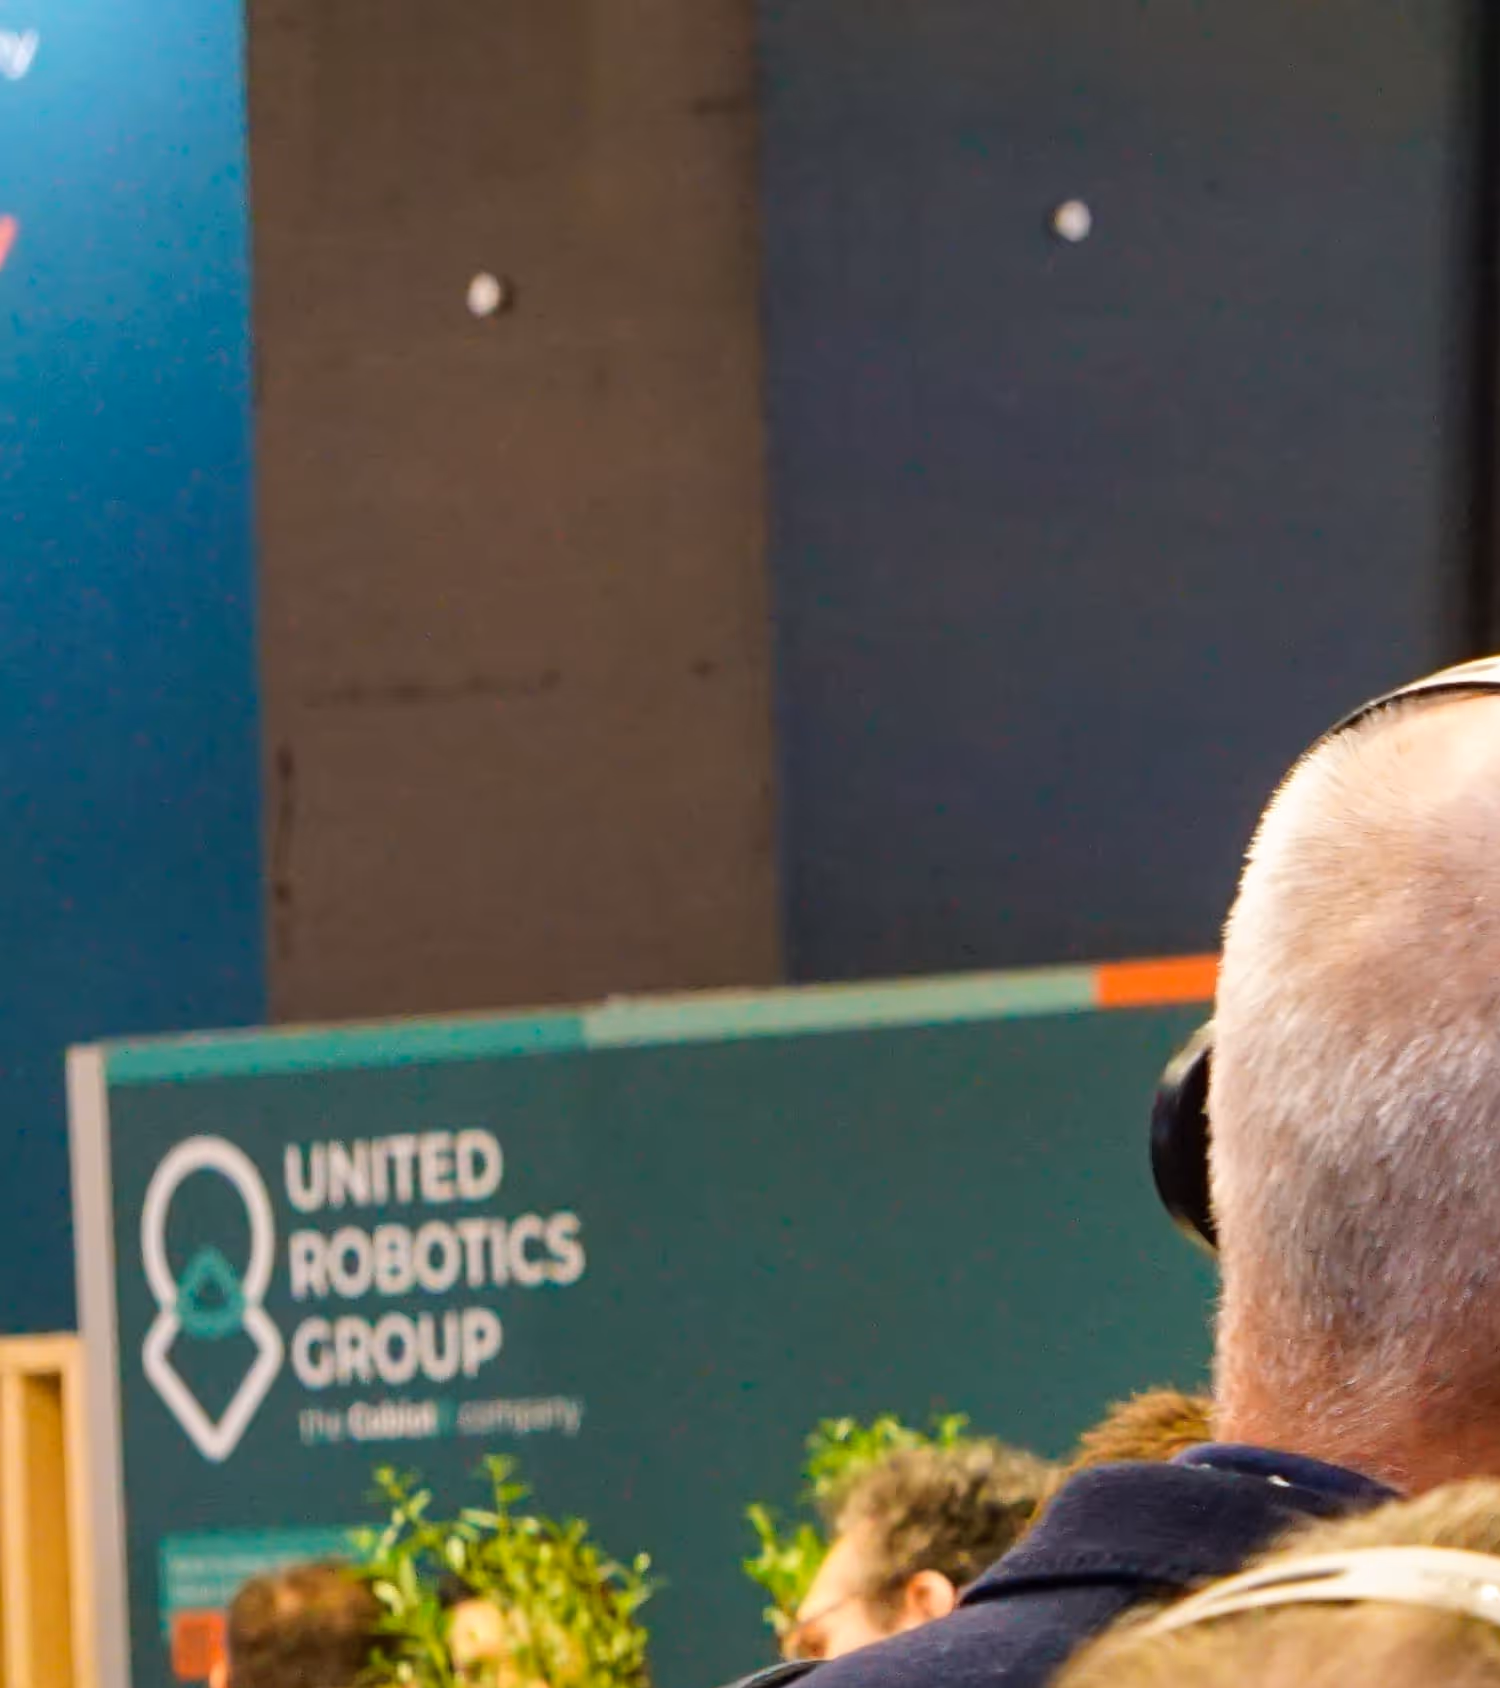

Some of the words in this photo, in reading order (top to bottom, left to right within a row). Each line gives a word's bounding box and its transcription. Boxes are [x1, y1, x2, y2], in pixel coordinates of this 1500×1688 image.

[285, 1129, 503, 1211] UNITED
[288, 1211, 585, 1299] ROBOTICS
[291, 1307, 503, 1388] GROUP
